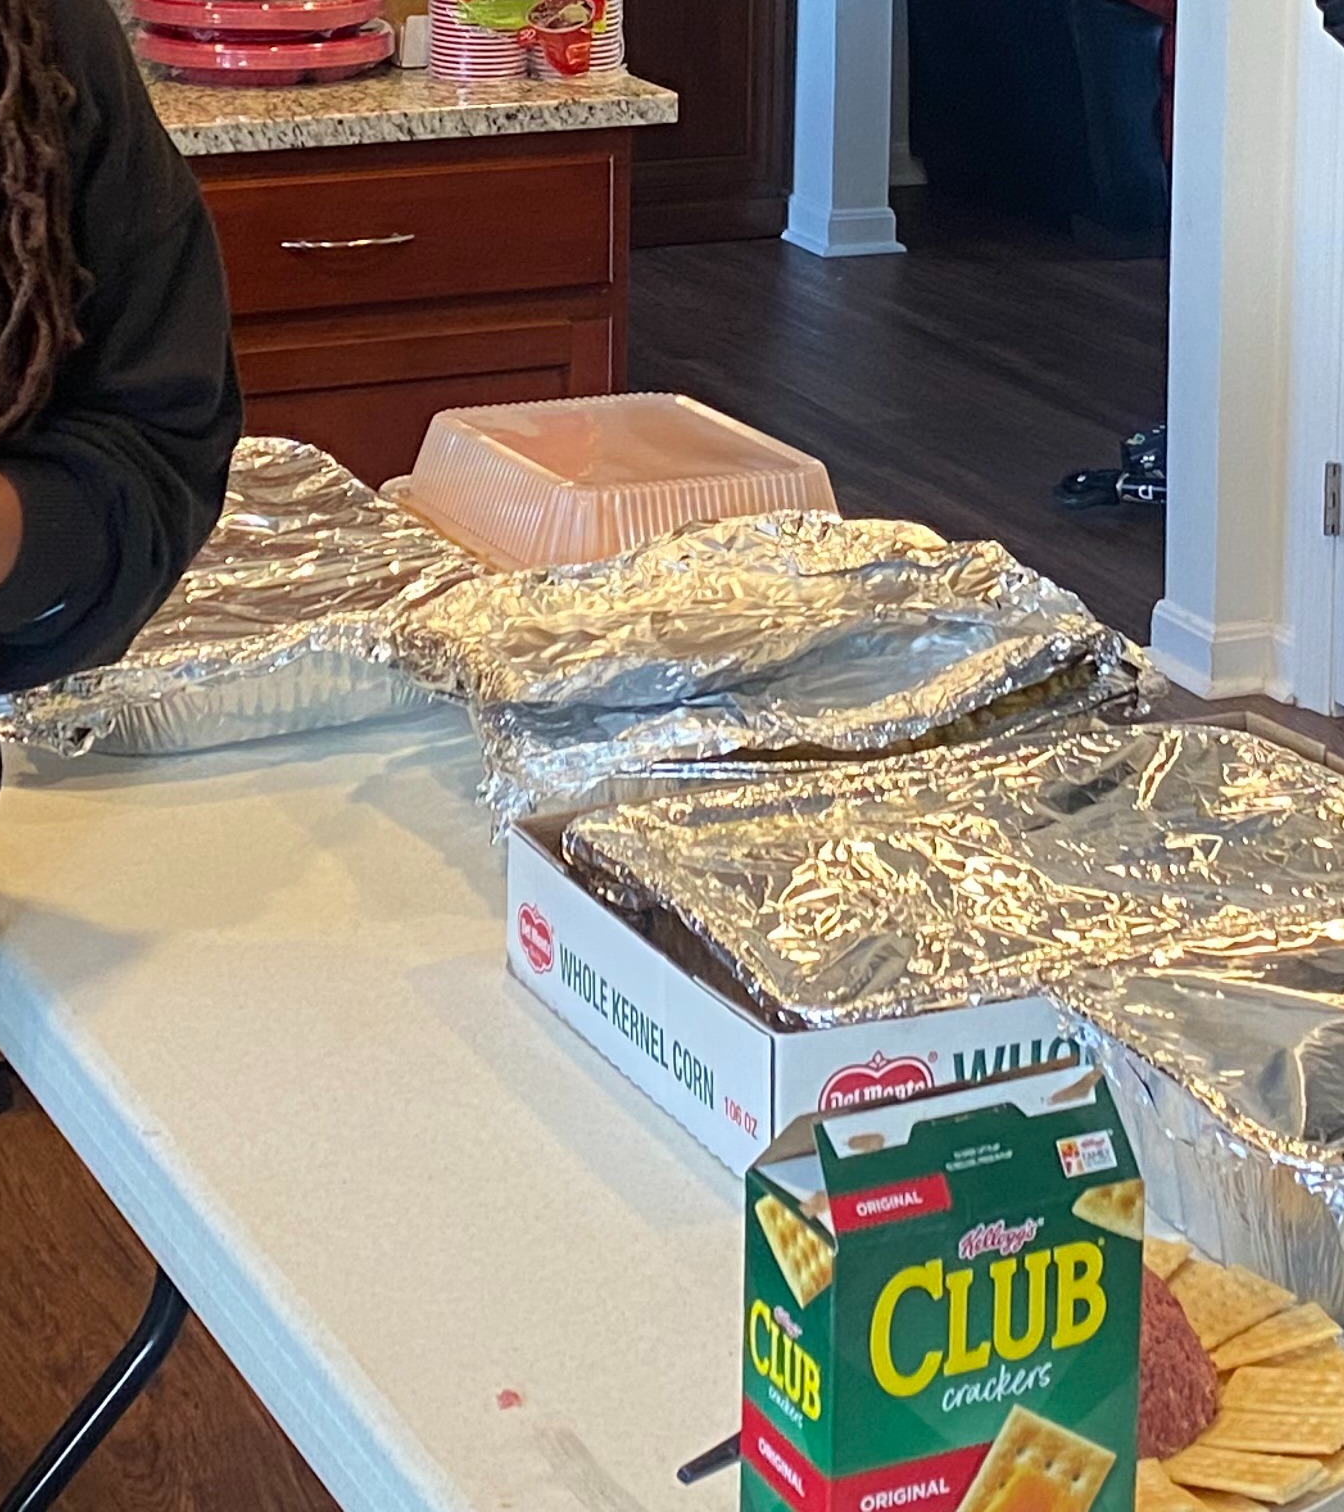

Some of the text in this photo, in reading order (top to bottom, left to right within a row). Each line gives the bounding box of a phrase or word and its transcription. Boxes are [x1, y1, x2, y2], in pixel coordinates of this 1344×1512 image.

[559, 942, 759, 1141] WHOLE KERNEL CORN 106 OZ
[855, 1190, 924, 1218] ORIGINAL
[958, 1217, 1038, 1260] Kellogg's
[869, 1240, 1108, 1398] CLUB
[749, 1299, 822, 1422] CLUB
[941, 1361, 1053, 1413] crackers
[758, 1436, 806, 1499] ORIGINAL
[859, 1476, 951, 1512] ORIGINAL
